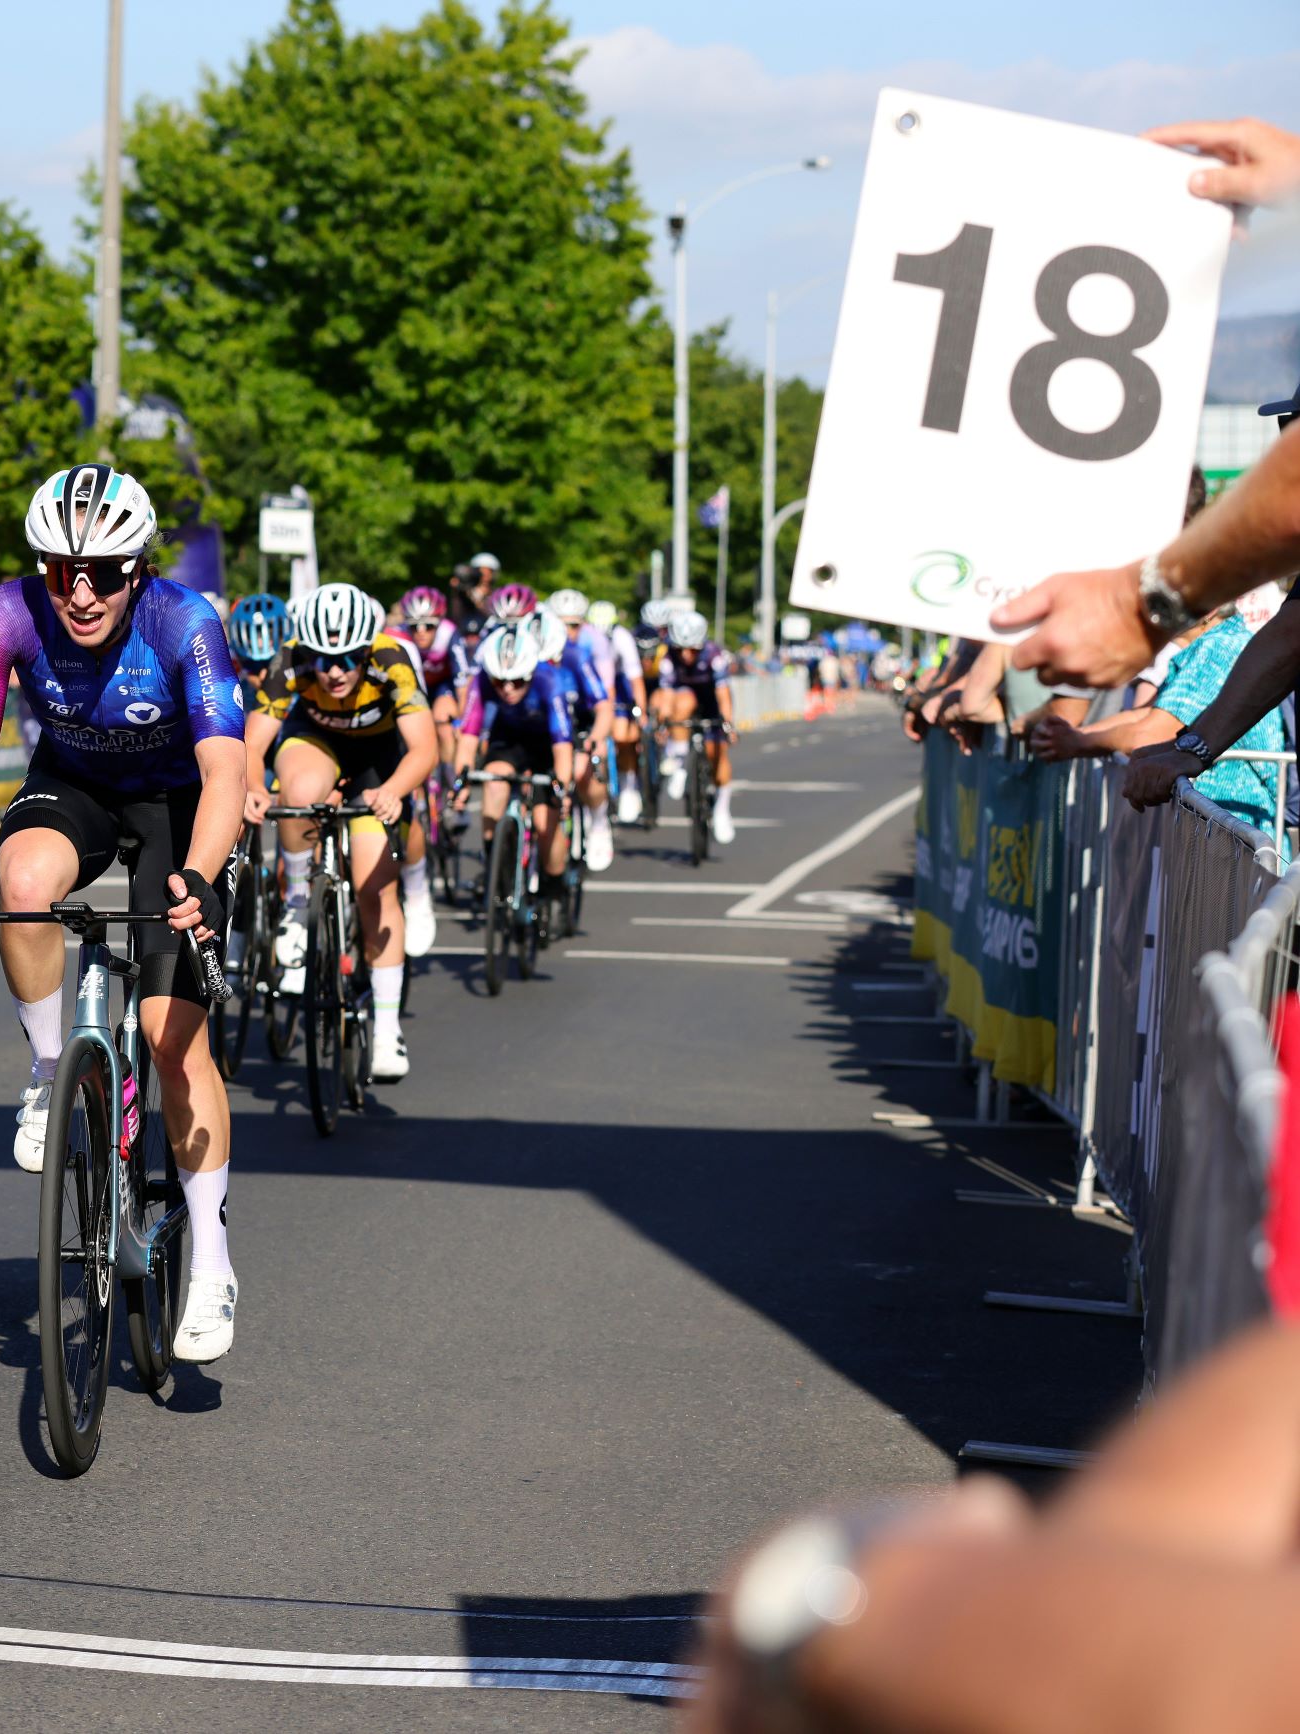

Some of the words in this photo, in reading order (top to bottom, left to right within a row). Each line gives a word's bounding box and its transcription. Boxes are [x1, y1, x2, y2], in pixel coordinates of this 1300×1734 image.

[892, 221, 1170, 462] 18
[54, 659, 83, 669] Wilson
[127, 668, 152, 676] FACTOR
[190, 633, 217, 716] MITCHELTON
[52, 722, 89, 741] SKIP
[95, 730, 171, 748] CAPITAL
[126, 737, 172, 753] COAST
